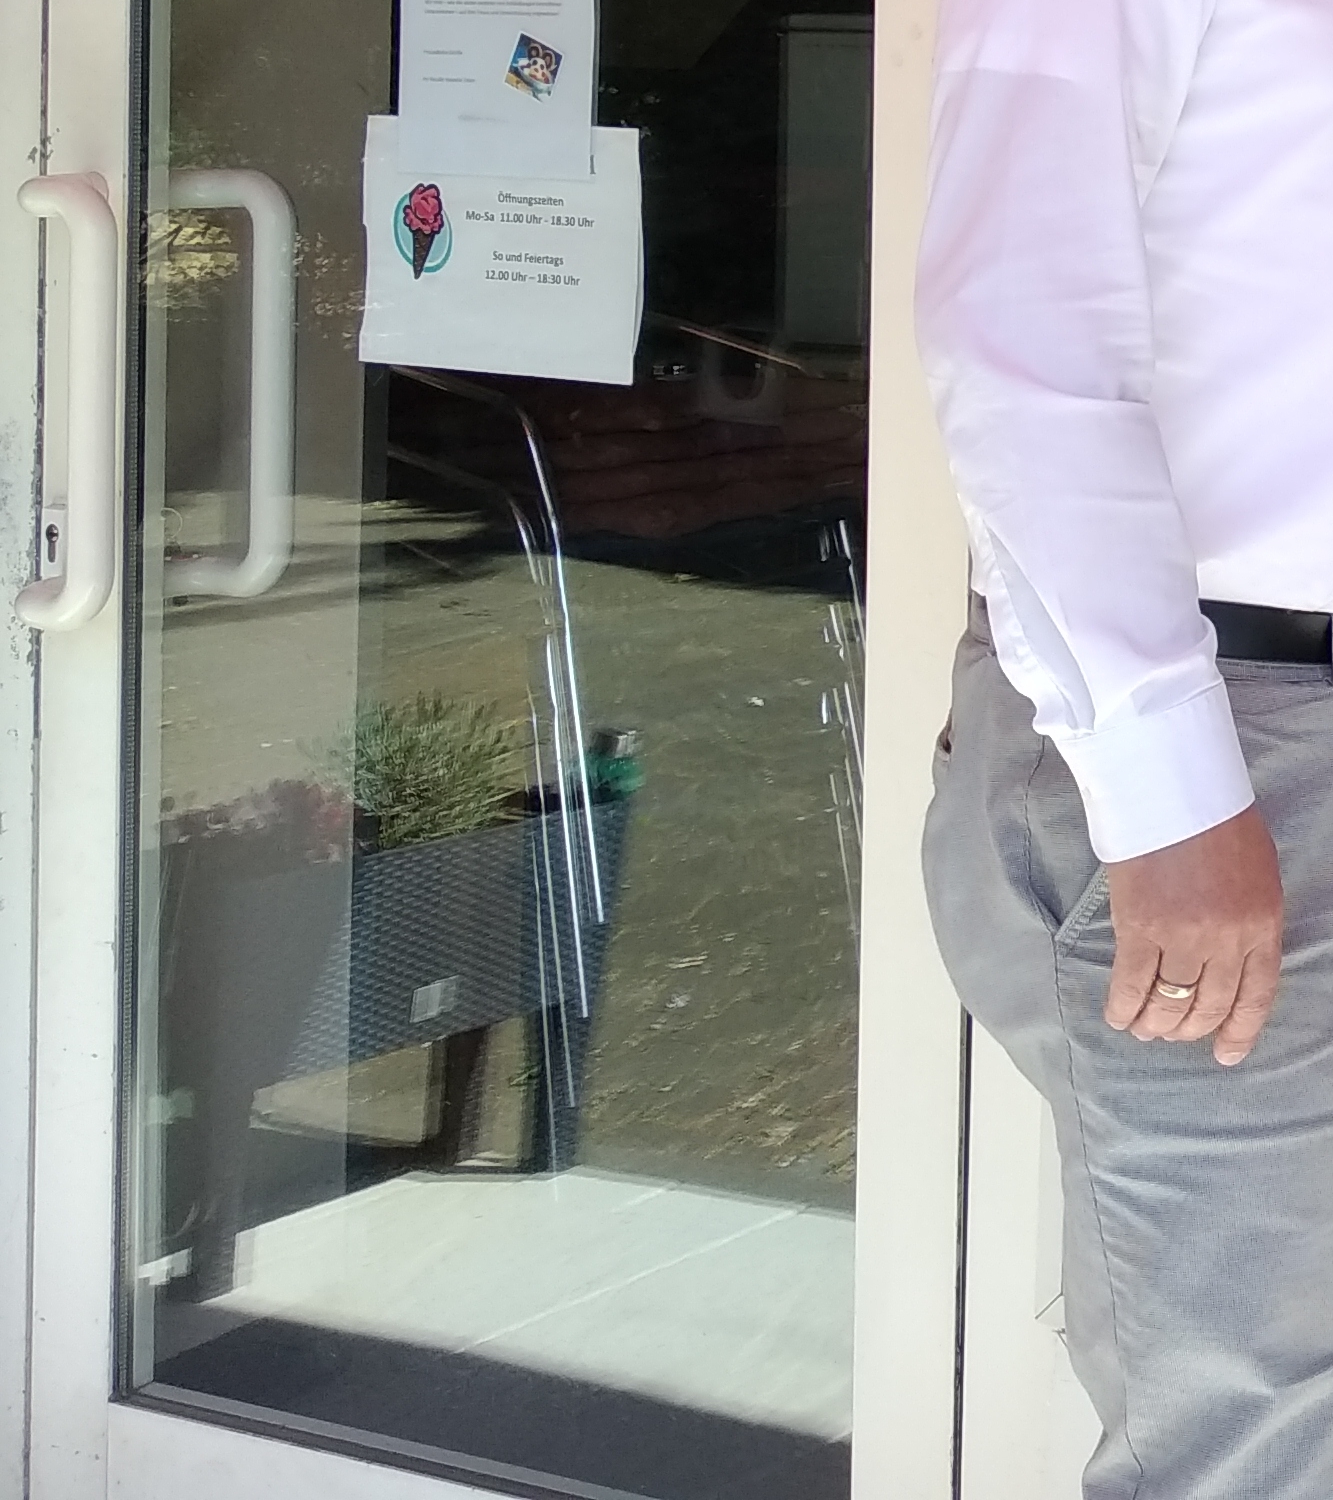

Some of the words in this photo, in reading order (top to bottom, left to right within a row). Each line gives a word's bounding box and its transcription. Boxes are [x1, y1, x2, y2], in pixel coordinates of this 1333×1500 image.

[497, 190, 564, 207] Öffnungszeiten
[465, 210, 495, 222] Mo-Sa
[499, 213, 524, 224] 11.00
[525, 213, 543, 225] Uhr
[550, 215, 576, 227] 18.30
[577, 216, 595, 228] Uhr
[492, 251, 504, 261] So
[505, 252, 522, 262] und
[524, 253, 564, 267] Feiertags
[485, 270, 509, 281] 12.00
[511, 271, 528, 282] Uhr
[563, 274, 581, 287] Uhr
